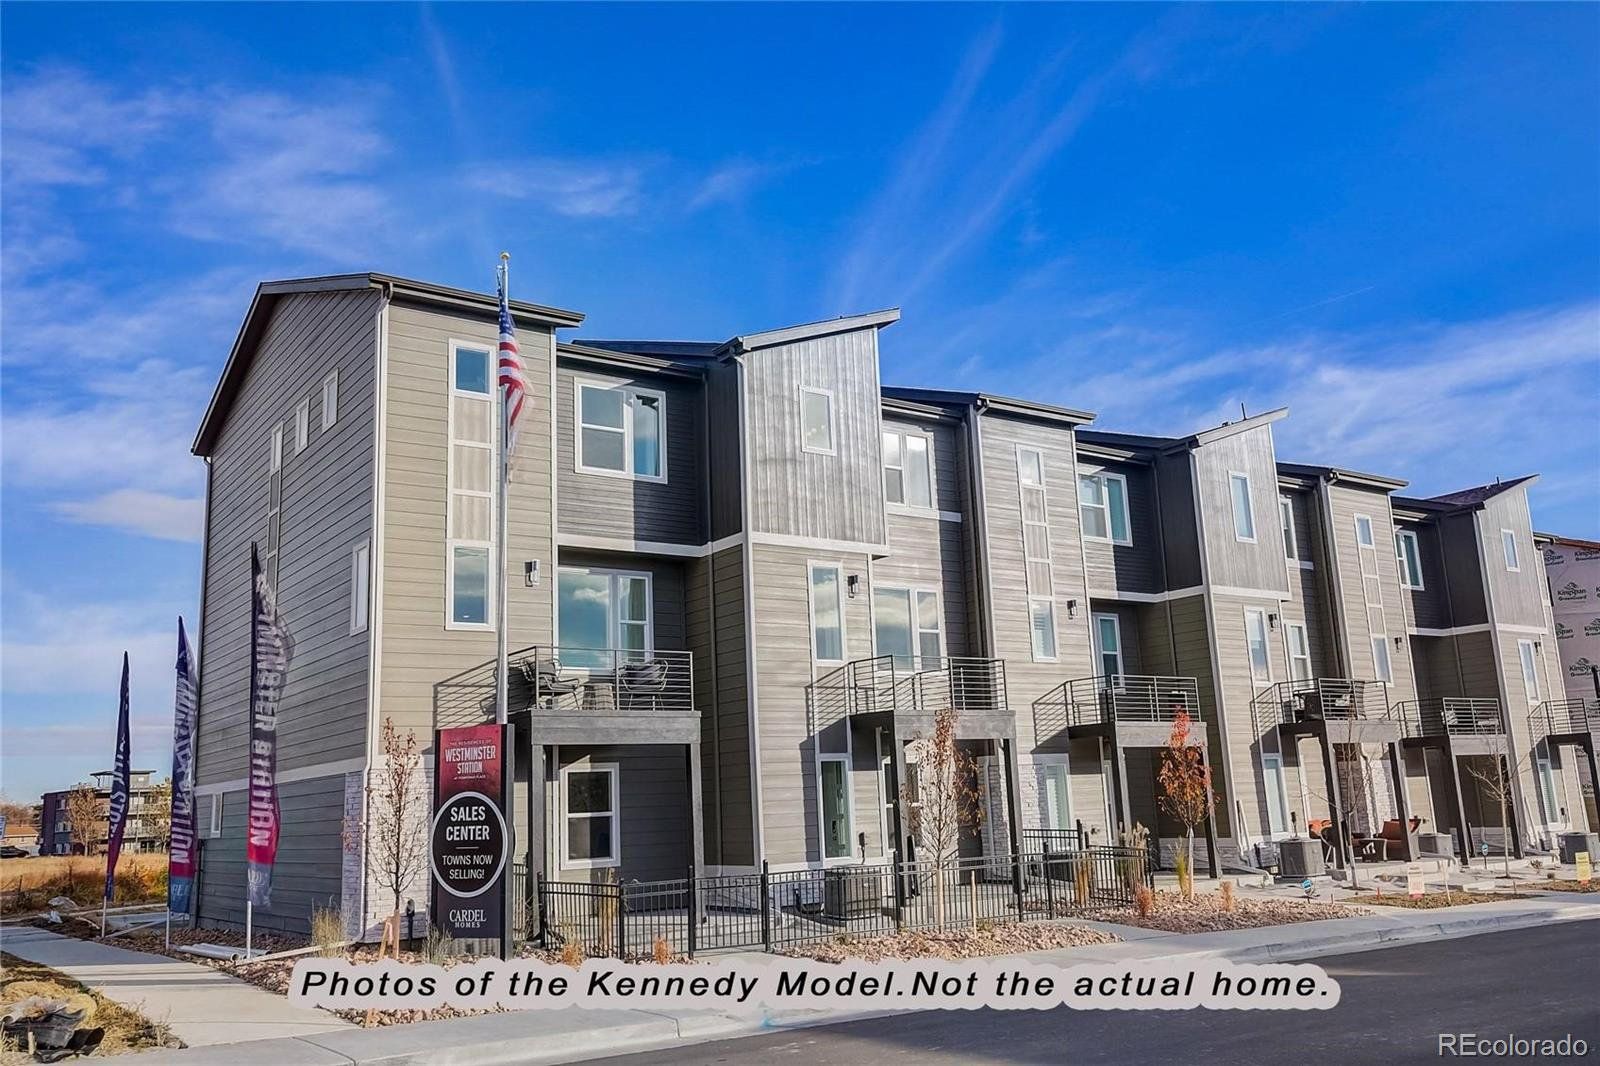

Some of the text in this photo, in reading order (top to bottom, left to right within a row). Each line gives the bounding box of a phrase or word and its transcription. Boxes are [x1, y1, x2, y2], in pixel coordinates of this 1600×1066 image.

[445, 745, 496, 762] WESTMINSTER
[457, 761, 483, 774] STATION
[450, 806, 486, 822] SALES
[446, 825, 490, 841] CENTER
[442, 854, 493, 866] TOWNS NOW
[449, 869, 485, 880] SELLING!
[449, 909, 487, 922] CARDEL
[455, 921, 481, 929] HOMES
